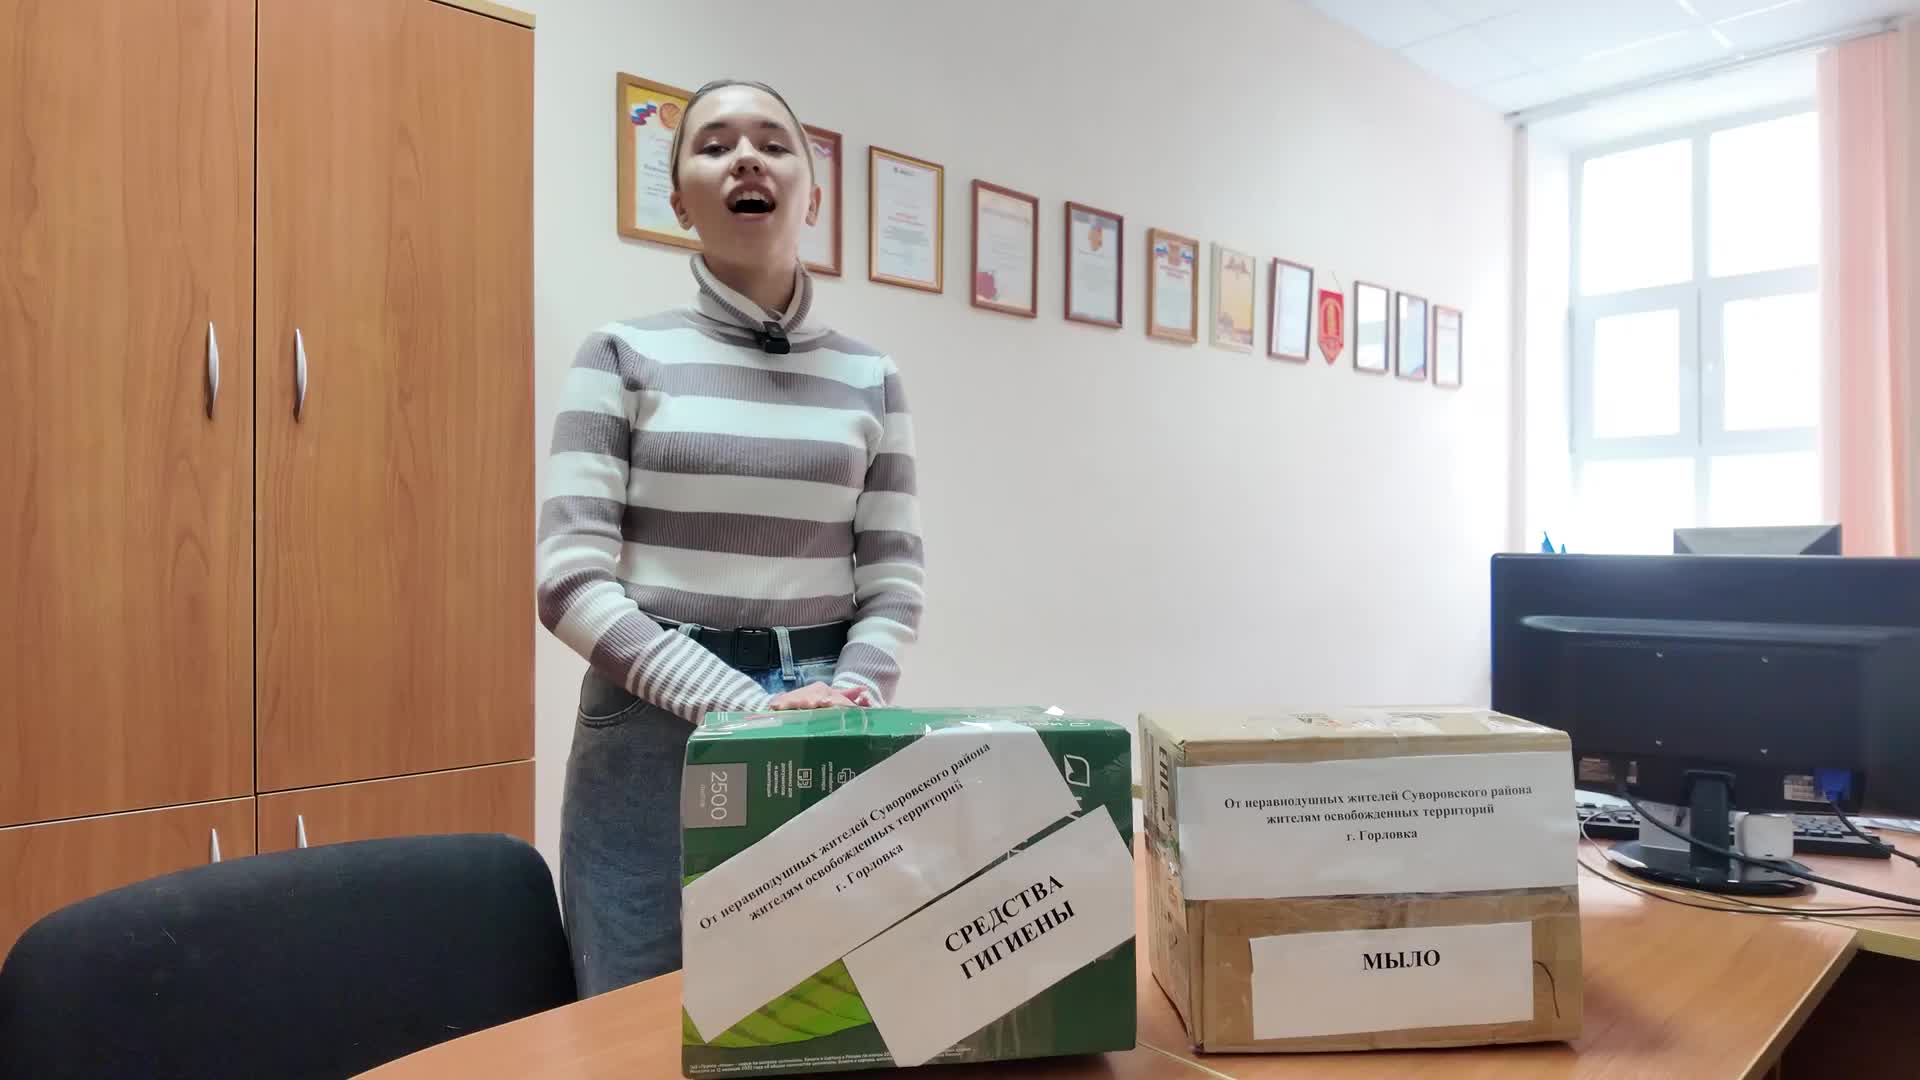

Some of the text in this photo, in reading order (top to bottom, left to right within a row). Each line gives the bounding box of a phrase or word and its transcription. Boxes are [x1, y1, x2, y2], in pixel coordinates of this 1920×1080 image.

[711, 771, 728, 820] 2500
[1224, 785, 1533, 811] От неравнодушных жителей Суворовского района
[1266, 803, 1495, 825] жителям освобожденных территорий
[699, 913, 719, 930] От
[720, 851, 819, 919] неравнодушных
[818, 815, 870, 858] жителей
[869, 770, 950, 823] Суворовского
[950, 743, 992, 777] района
[748, 778, 964, 921] жителям освобожденных территорий
[1346, 830, 1418, 844] г. Горловка
[835, 844, 904, 893] г. Горловка
[944, 875, 1065, 953] СРЕДСТВА
[959, 899, 1076, 980] ГИГИЕНЫ
[1361, 949, 1441, 971] МЫЛО
